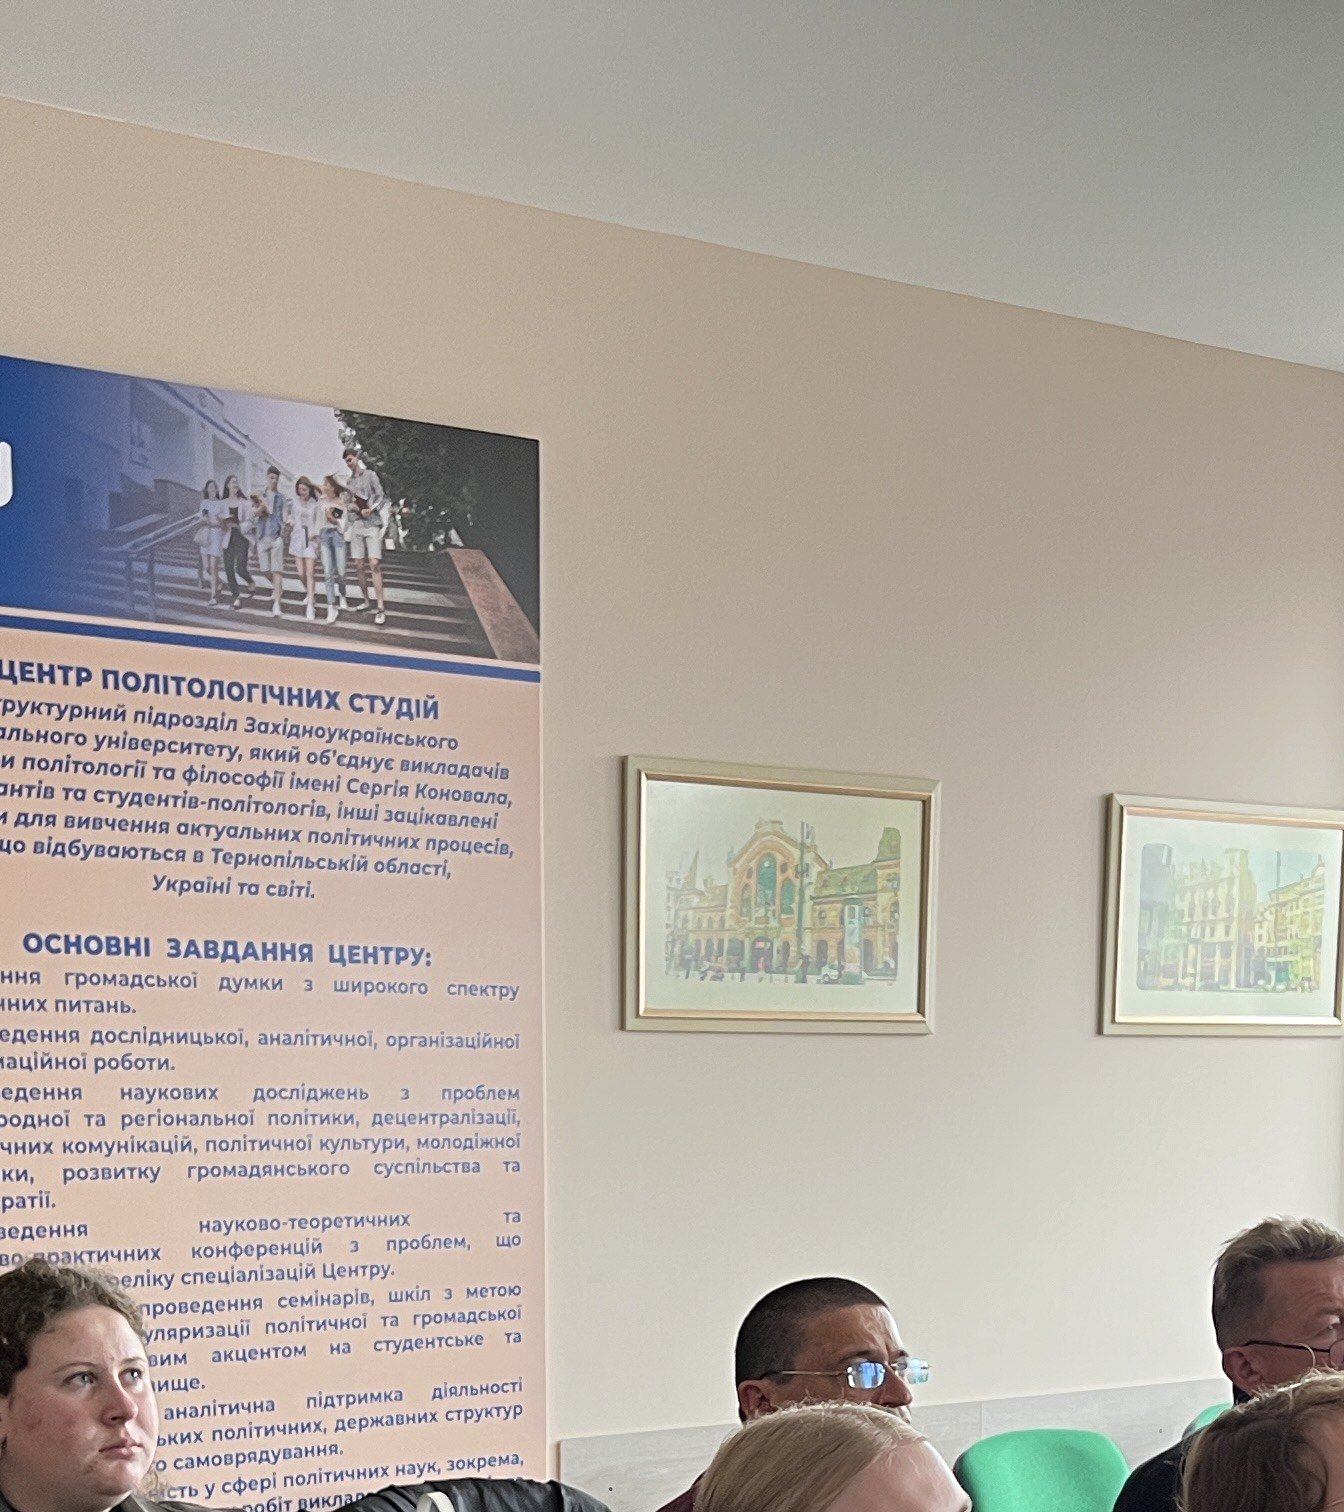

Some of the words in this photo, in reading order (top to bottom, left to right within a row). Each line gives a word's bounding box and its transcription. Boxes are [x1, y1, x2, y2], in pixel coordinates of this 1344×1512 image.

[102, 668, 341, 711] ПОЛІТОЛОГІЧНИХ
[348, 693, 439, 721] СТУДІЙ
[133, 705, 238, 732] підрозділ
[244, 716, 458, 750] Західноукраїнського
[93, 730, 243, 762] університету,
[250, 746, 300, 763] який
[400, 759, 509, 780] викладачів
[22, 754, 148, 778] політології
[152, 766, 176, 780] та
[182, 764, 285, 791] філософії
[289, 771, 341, 792] імені
[347, 778, 409, 799] Сергія
[415, 783, 512, 809] Коновала,
[62, 787, 87, 802] та
[93, 789, 331, 821] студентів-політологів,
[337, 801, 379, 821] інші
[384, 806, 498, 829] зацікавлені
[14, 812, 57, 828] для
[64, 815, 170, 834] вивчення
[176, 822, 302, 842] актуальних
[308, 828, 420, 849] політичних
[426, 838, 513, 858] процесів,
[33, 836, 186, 862] відбуваються
[193, 850, 204, 863] в
[211, 848, 368, 872] Тернопільській
[374, 857, 451, 880] області,
[152, 874, 232, 897] Україні
[238, 882, 260, 895] та
[266, 880, 314, 898] світі.
[22, 932, 150, 957] ОСНОВНІ
[167, 938, 313, 964] ЗАВДАННЯ
[329, 944, 431, 967] ЦЕНТРУ:
[65, 971, 198, 990] громадської
[219, 977, 282, 993] думки
[304, 979, 313, 991] з
[334, 980, 428, 996] широкого
[447, 984, 519, 1001] спектру
[55, 999, 136, 1013] питань.
[90, 1026, 248, 1048] дослідницької,
[258, 1029, 377, 1050] аналітичної,
[386, 1032, 519, 1051] організаційної
[94, 1052, 175, 1074] роботи.
[120, 1087, 218, 1105] наукових
[253, 1083, 368, 1103] досліджень
[401, 1089, 409, 1100] з
[442, 1084, 519, 1104] проблем
[84, 1114, 106, 1127] та
[121, 1108, 255, 1131] регіональної
[268, 1108, 359, 1128] політики,
[371, 1108, 520, 1128] децентралізації,
[62, 1135, 198, 1158] комунікацій,
[206, 1134, 312, 1152] політичної
[320, 1138, 410, 1155] культури,
[417, 1133, 520, 1151] молодіжної
[63, 1166, 161, 1185] розвитку
[188, 1163, 350, 1182] громадянського
[374, 1157, 480, 1178] суспільства
[503, 1161, 520, 1172] та
[199, 1215, 410, 1236] науково-теоретичних
[503, 1211, 521, 1223] та
[192, 1237, 322, 1262] конференцій
[350, 1241, 359, 1253] з
[387, 1234, 470, 1254] проблем,
[496, 1235, 521, 1248] що
[181, 1262, 315, 1285] спеціалізацій
[322, 1261, 395, 1280] Центру.
[278, 1288, 374, 1309] семінарів,
[389, 1285, 431, 1303] шкіл
[444, 1288, 453, 1300] з
[466, 1285, 521, 1299] метою
[265, 1315, 367, 1335] політичної
[381, 1315, 399, 1327] та
[413, 1304, 522, 1329] громадської
[212, 1345, 306, 1363] акцентом
[330, 1342, 351, 1355] на
[374, 1334, 484, 1355] студентське
[504, 1332, 521, 1343] та
[164, 1399, 275, 1421] аналітична
[307, 1390, 403, 1410] підтримка
[432, 1377, 522, 1401] діяльності
[212, 1420, 327, 1442] політичних,
[334, 1411, 438, 1433] державних
[445, 1404, 523, 1424] структур
[173, 1443, 344, 1468] самоврядування.
[221, 1472, 277, 1496] сфері
[283, 1466, 389, 1488] політичних
[395, 1461, 441, 1478] наук,
[447, 1454, 524, 1472] зокрема,
